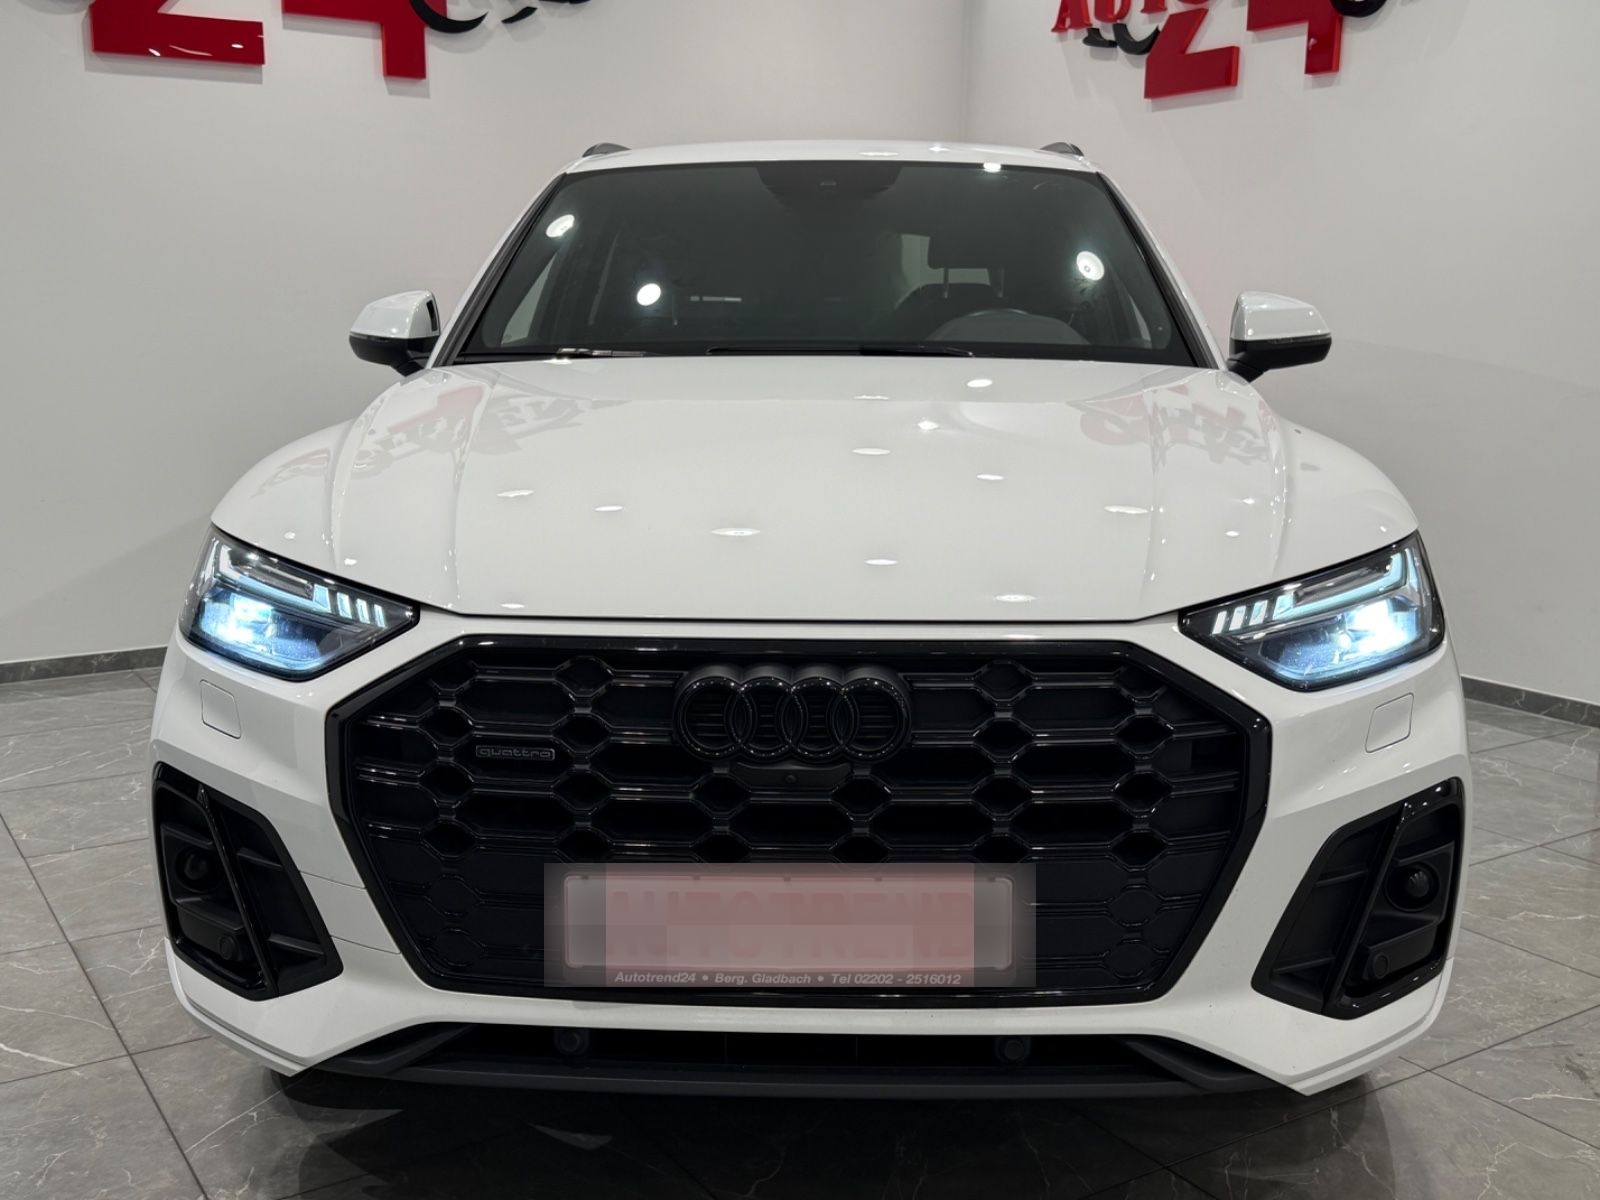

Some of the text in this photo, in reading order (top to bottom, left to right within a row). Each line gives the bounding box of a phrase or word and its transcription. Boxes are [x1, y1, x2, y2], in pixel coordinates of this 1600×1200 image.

[479, 747, 552, 758] quattro
[614, 971, 697, 984] Autotrend24
[714, 972, 748, 986] Berg.
[752, 972, 811, 985] Gladbach
[831, 973, 851, 985] Tel
[854, 973, 894, 985] 02202
[906, 974, 962, 985] 2516012
